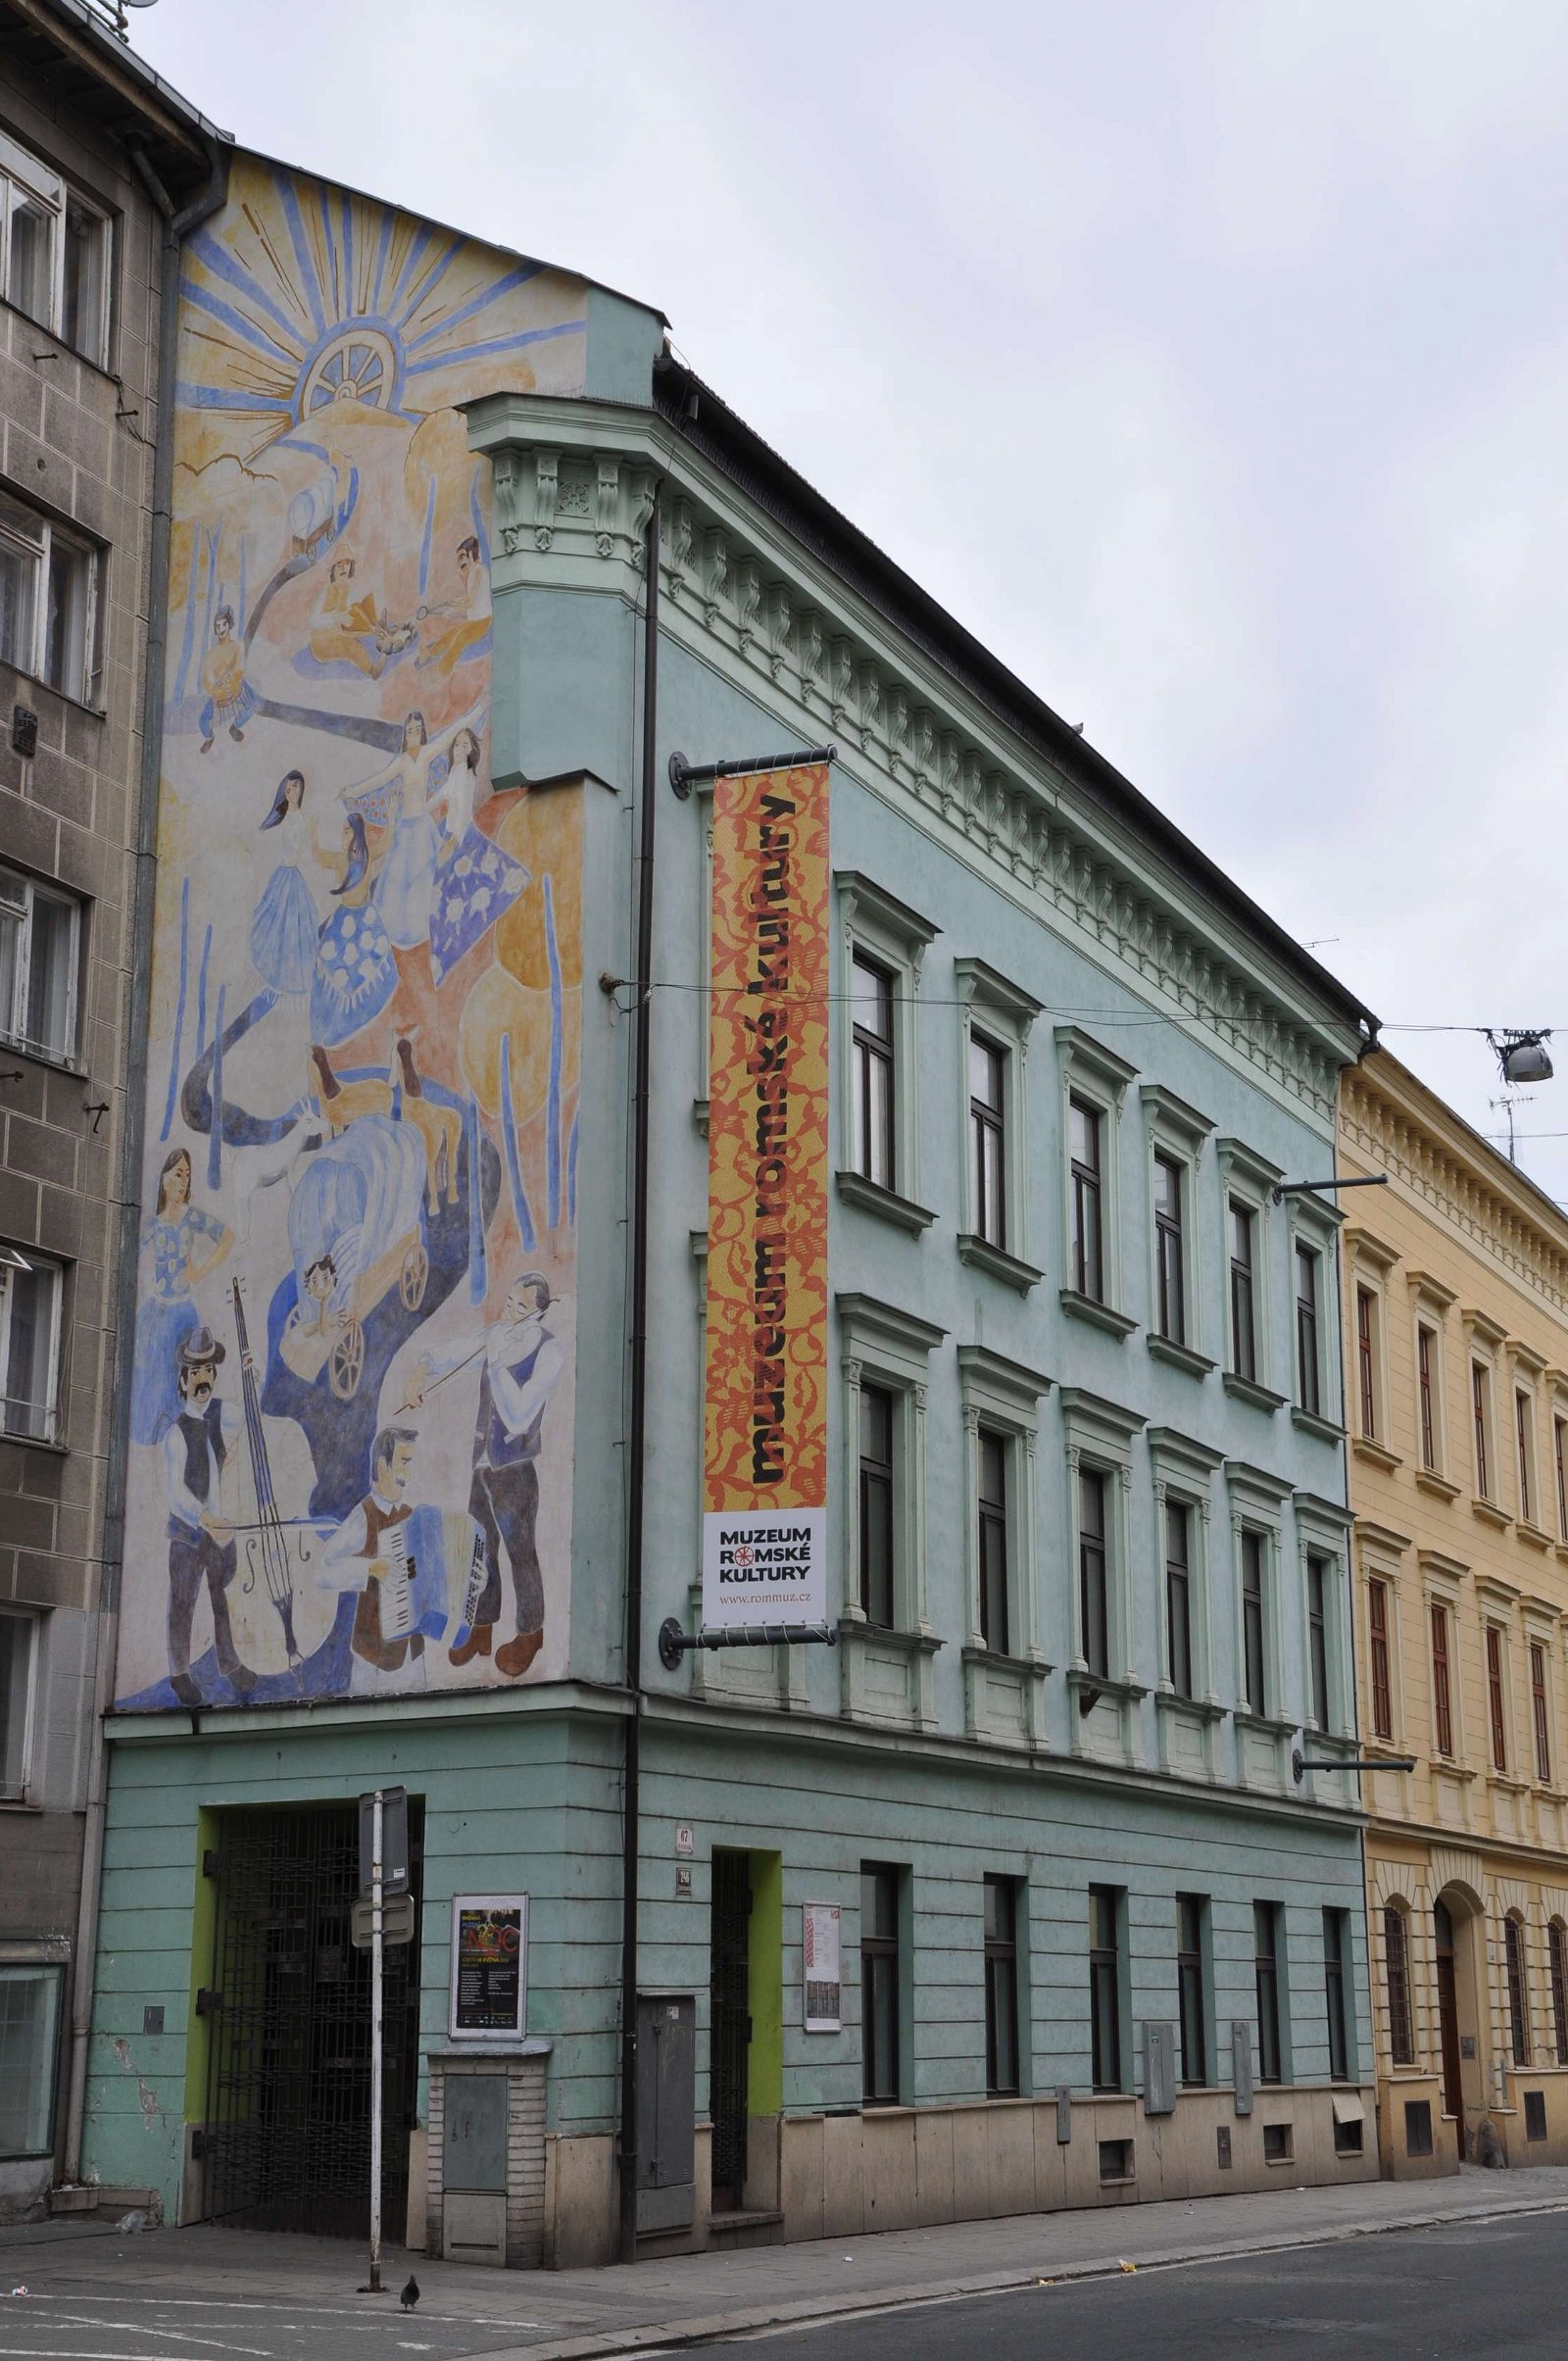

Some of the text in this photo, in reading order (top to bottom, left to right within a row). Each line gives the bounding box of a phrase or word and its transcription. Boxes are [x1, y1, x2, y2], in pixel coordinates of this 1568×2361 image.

[744, 794, 796, 1483] muzeum romské kultury
[720, 1527, 811, 1546] MUZEUM
[720, 1543, 811, 1567] ROMSKÉ
[720, 1565, 811, 1584] KULTURY
[719, 1593, 811, 1604] www.rommuz.cz
